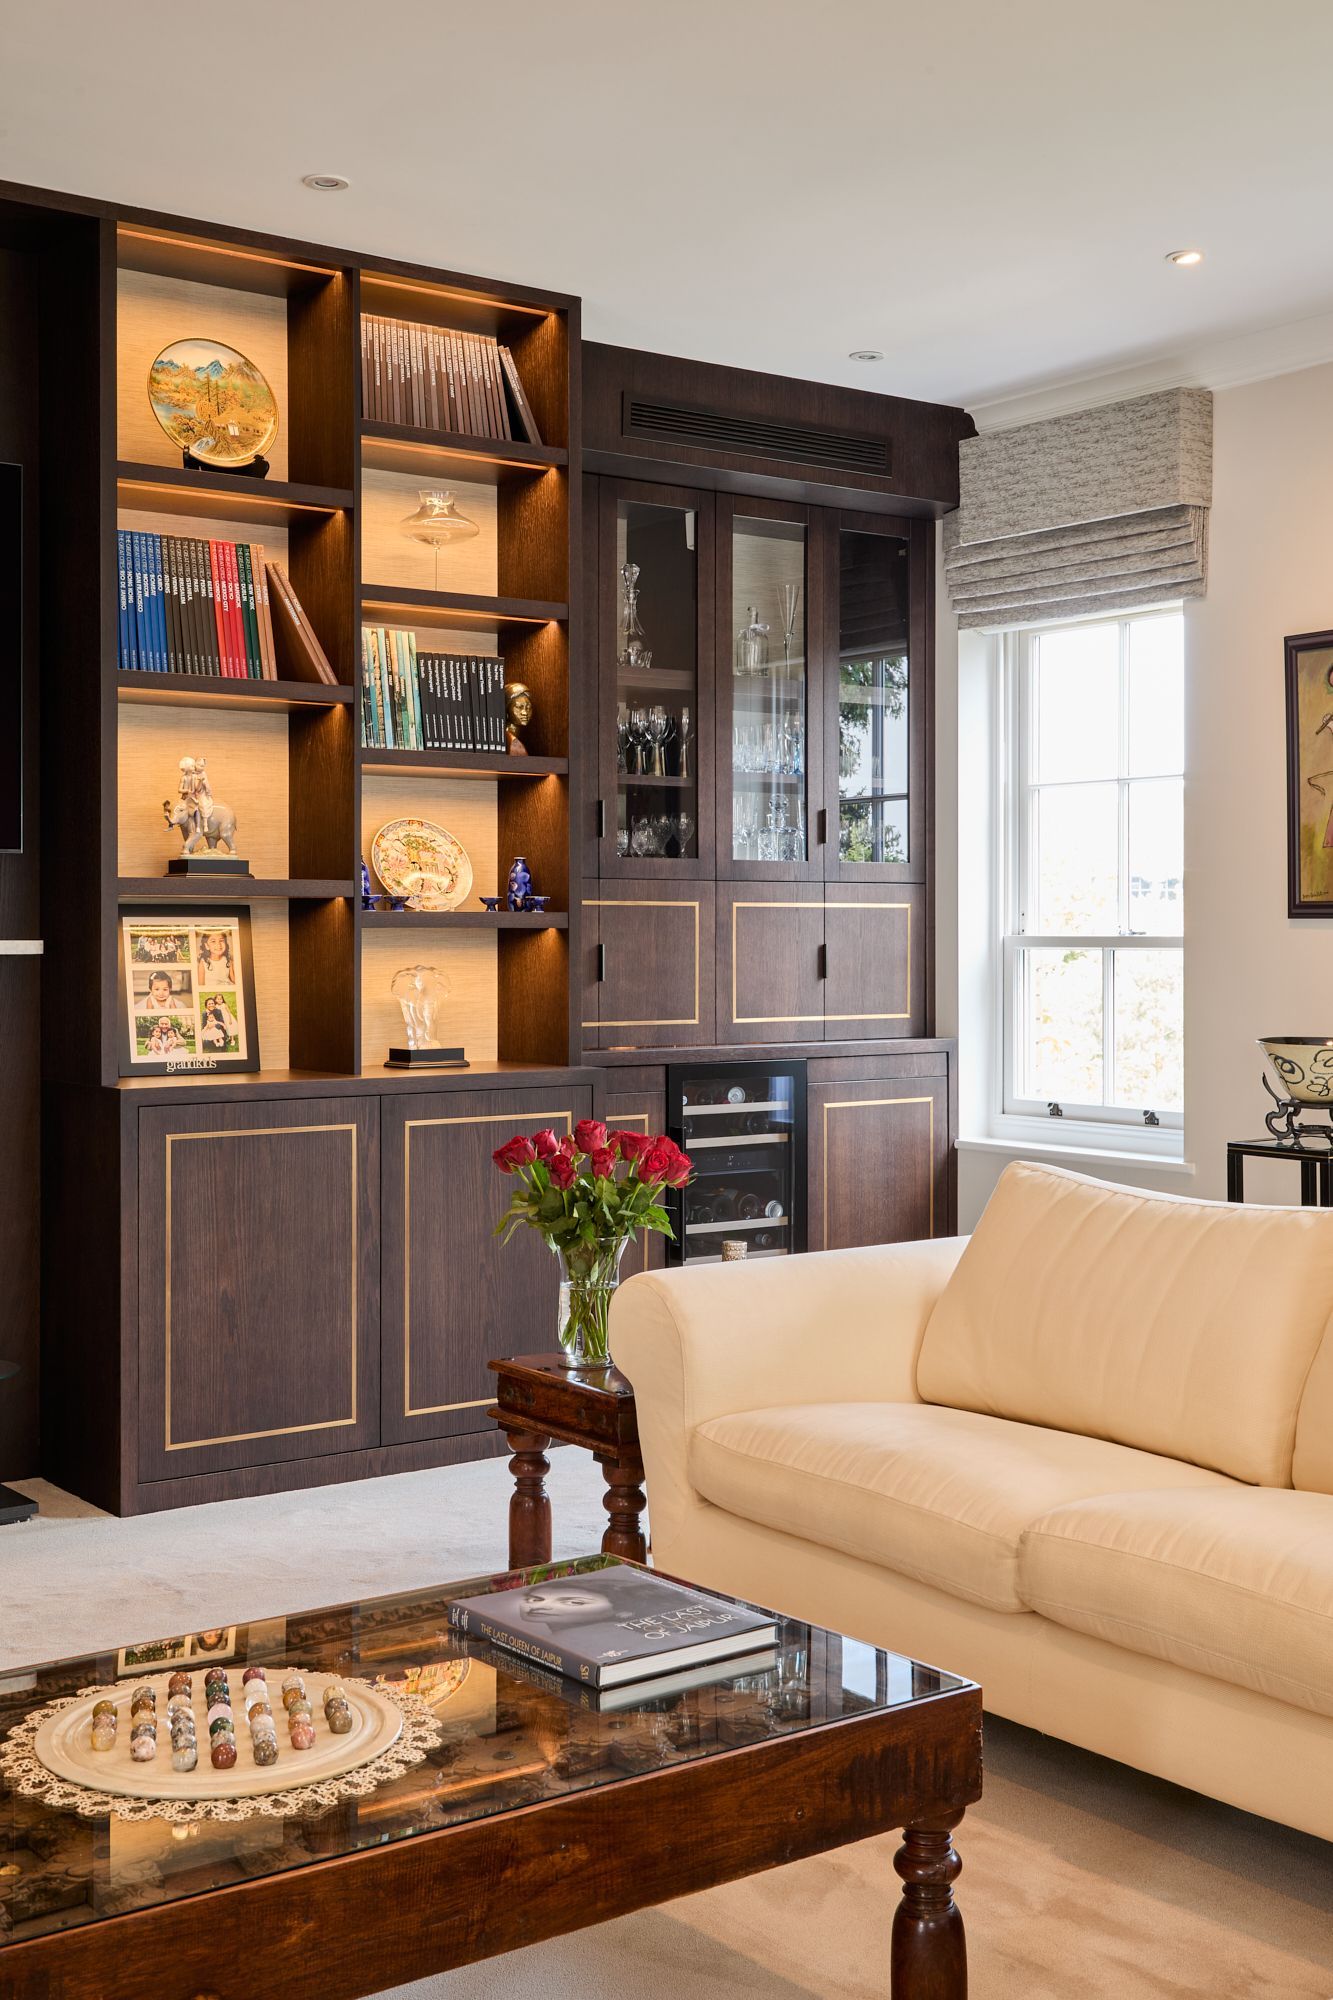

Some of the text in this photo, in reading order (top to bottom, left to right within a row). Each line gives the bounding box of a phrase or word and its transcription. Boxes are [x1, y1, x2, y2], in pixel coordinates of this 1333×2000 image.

[166, 1056, 217, 1073] grandkids
[615, 1604, 711, 1631] THE LAST
[644, 1613, 738, 1639] OF JAIPUR
[481, 1623, 492, 1636] THE
[492, 1628, 508, 1643] LAST
[509, 1636, 530, 1653] QUEEN
[531, 1645, 541, 1657] OF
[541, 1649, 562, 1667] JAIPUR
